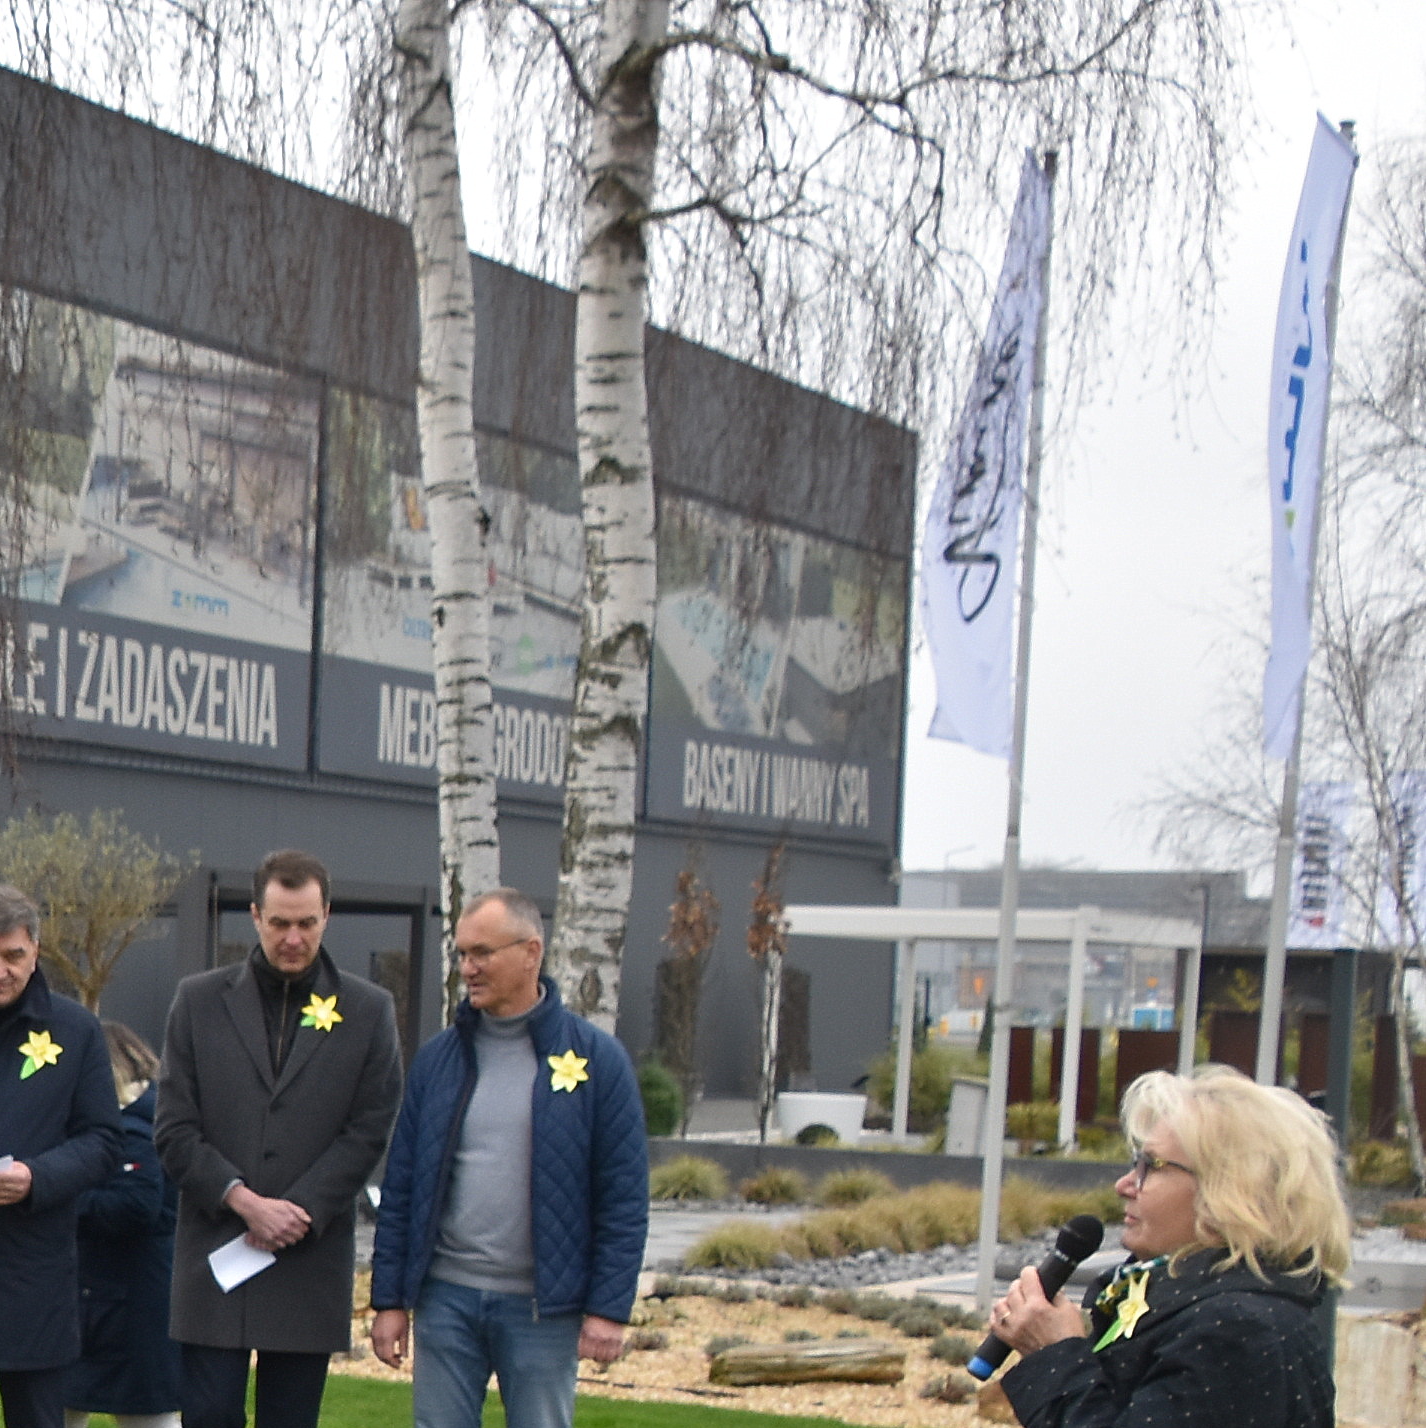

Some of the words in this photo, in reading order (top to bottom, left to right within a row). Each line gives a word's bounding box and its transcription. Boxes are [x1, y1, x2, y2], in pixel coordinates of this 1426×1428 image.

[56, 626, 68, 719] I
[75, 629, 278, 748] ZADASZENIA
[378, 682, 438, 769] MEB
[683, 740, 761, 816] BASENY
[836, 762, 870, 829] SPA
